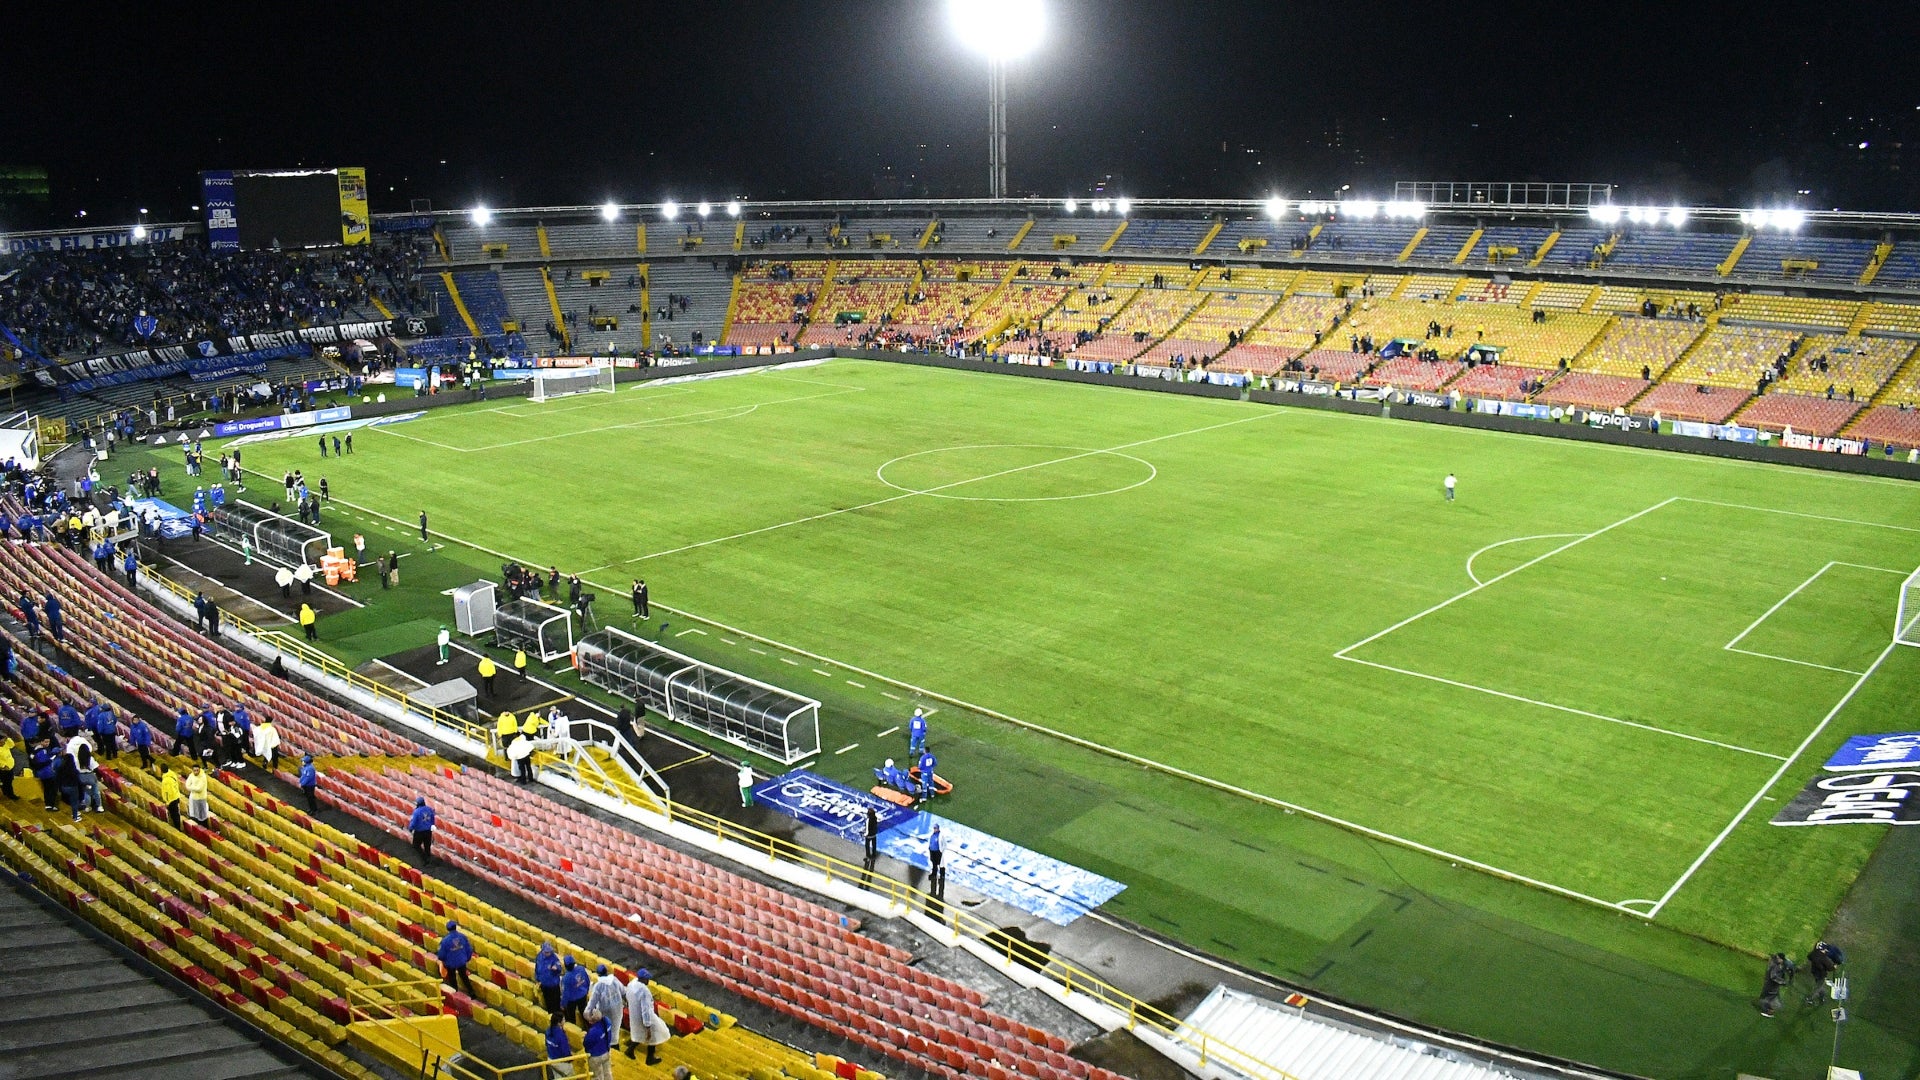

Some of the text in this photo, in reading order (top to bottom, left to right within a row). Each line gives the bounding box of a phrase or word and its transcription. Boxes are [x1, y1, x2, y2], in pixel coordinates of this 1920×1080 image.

[92, 228, 175, 249] FUTOL
[228, 336, 249, 353] NO
[299, 326, 338, 342] PARA
[340, 321, 395, 340] AMARTE
[1783, 431, 1812, 450] PIERRE
